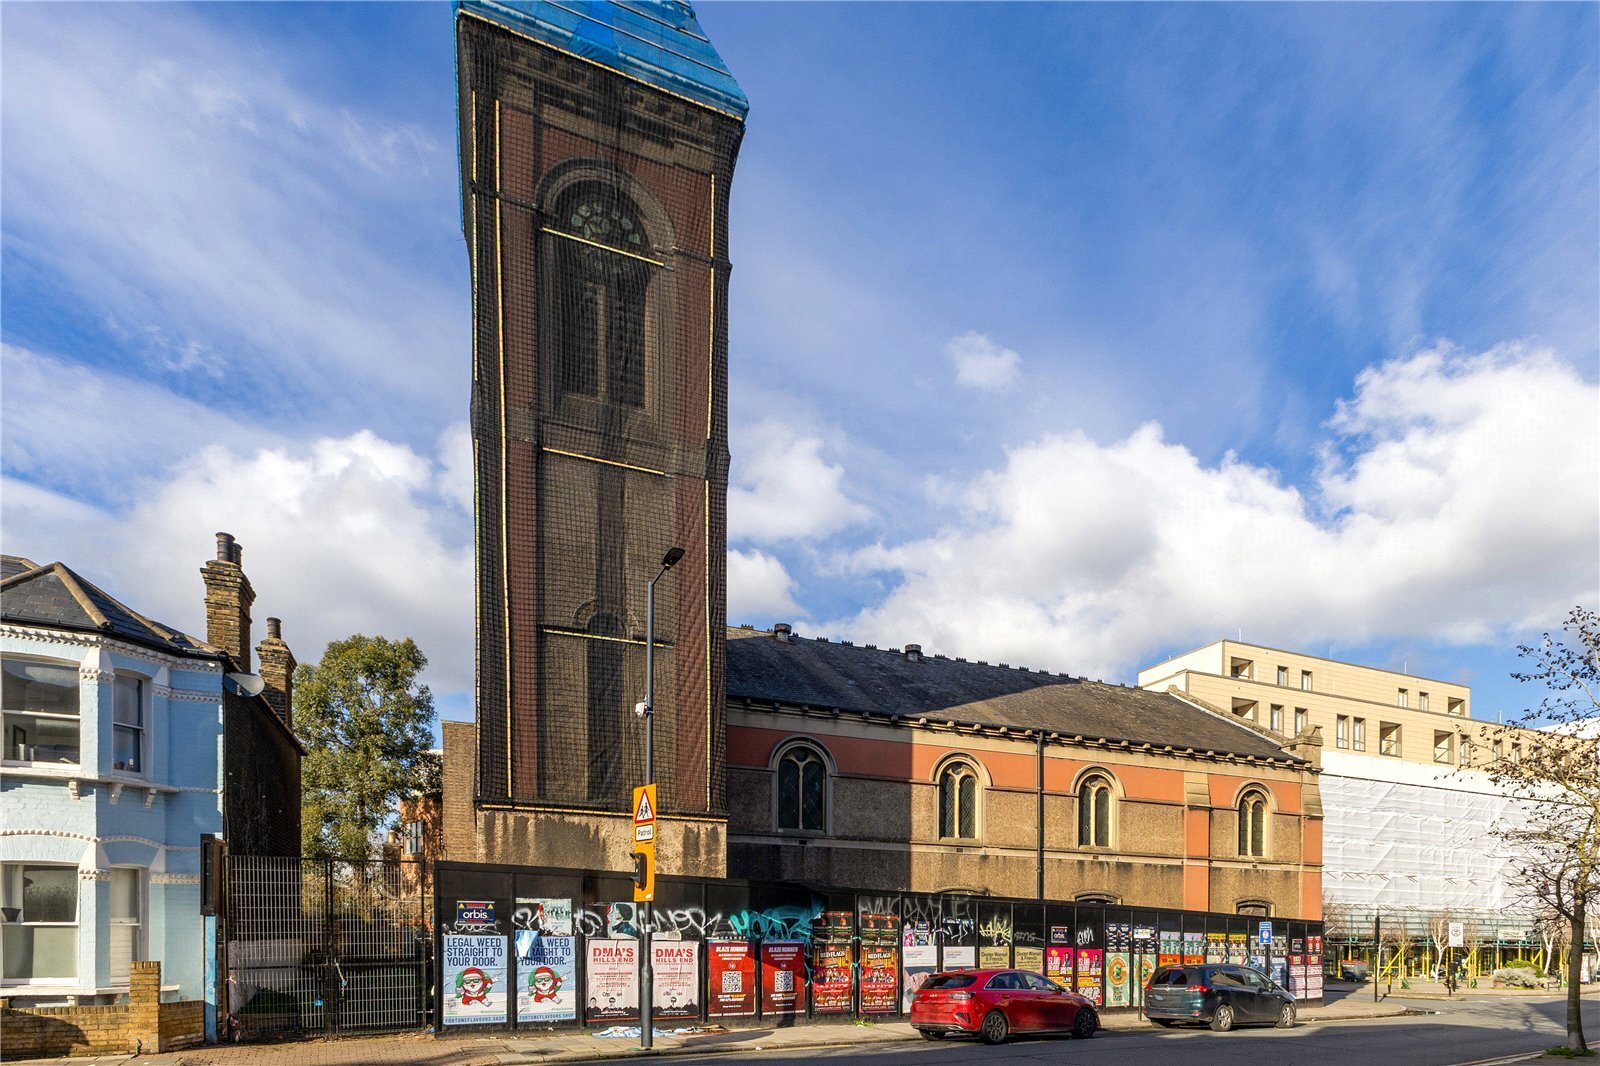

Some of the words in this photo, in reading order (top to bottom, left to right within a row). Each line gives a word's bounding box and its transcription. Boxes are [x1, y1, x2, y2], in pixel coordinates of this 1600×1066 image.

[637, 827, 652, 837] Patrol
[447, 937, 475, 948] LEGAL
[476, 938, 502, 948] WEED
[546, 938, 570, 947] WEED
[446, 947, 490, 957] STRAIGHT
[492, 947, 503, 957] TO
[560, 947, 571, 956] TO
[592, 947, 634, 957] DMA'S
[655, 948, 694, 958] DMA'S
[447, 956, 471, 967] YOUR
[472, 956, 498, 966] DOOR.
[519, 956, 542, 966] YOUR
[543, 956, 567, 966] DOOR.
